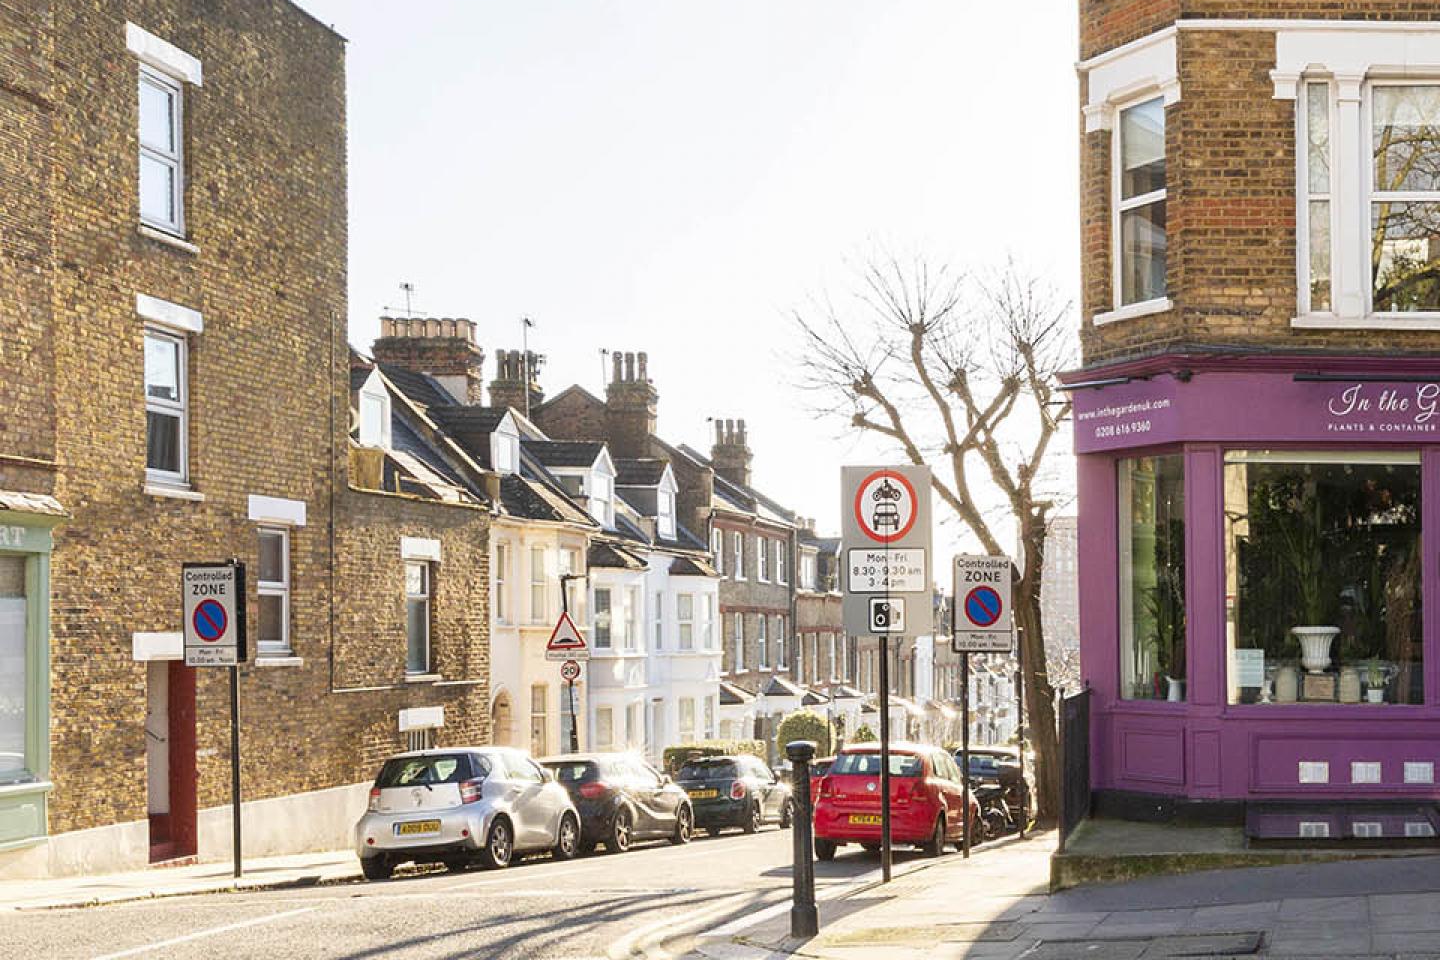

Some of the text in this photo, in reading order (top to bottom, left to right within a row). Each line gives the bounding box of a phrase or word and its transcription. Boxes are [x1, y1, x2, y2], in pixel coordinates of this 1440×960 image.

[1328, 384, 1371, 416] In
[1379, 389, 1409, 412] the
[1328, 423, 1364, 431] PLANTS
[1379, 423, 1435, 431] CONTAINER
[867, 553, 887, 562] Mon
[958, 559, 1008, 569] Controlled
[186, 571, 232, 581] Controlled
[965, 571, 1001, 582] ZONE
[192, 584, 226, 595] ZONE
